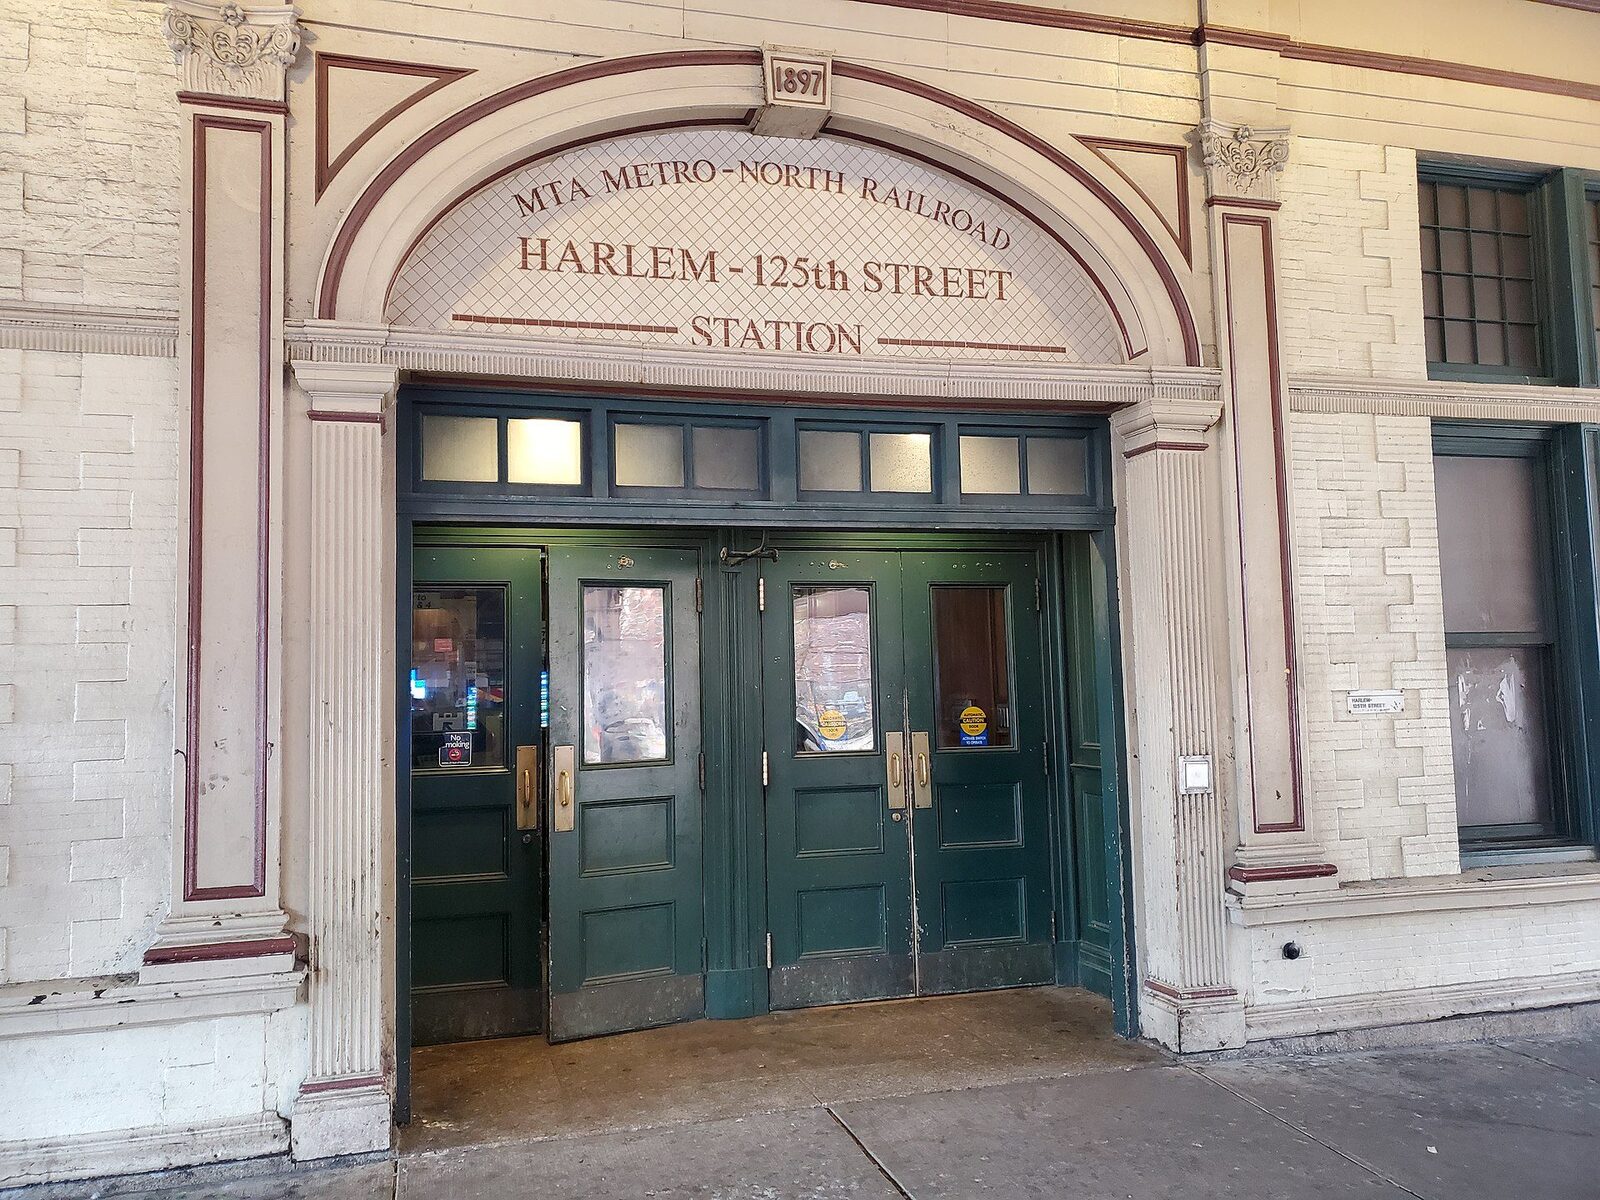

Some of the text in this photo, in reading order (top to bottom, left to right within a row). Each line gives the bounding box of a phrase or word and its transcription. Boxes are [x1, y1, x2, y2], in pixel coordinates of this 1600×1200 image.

[776, 66, 822, 96] 1897
[511, 177, 592, 218] MTA
[859, 176, 1011, 250] RAILROAD
[863, 260, 1013, 301] STREET
[691, 315, 864, 354] STATION
[445, 741, 470, 749] moking
